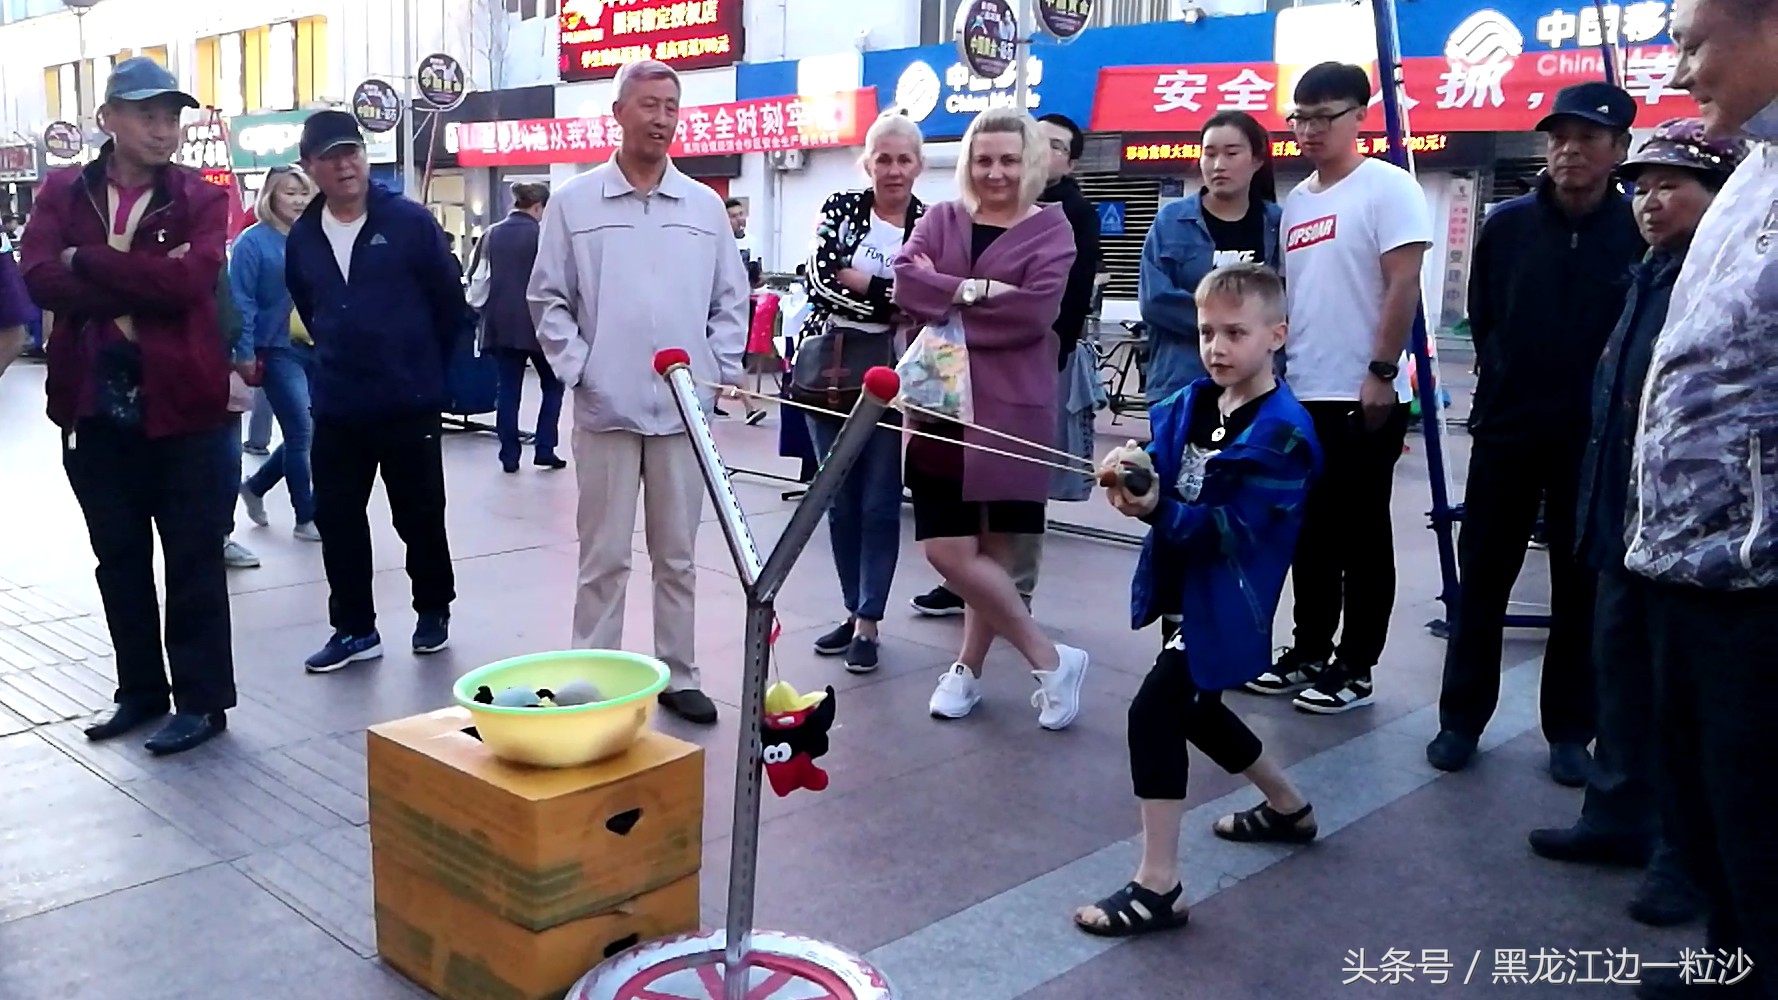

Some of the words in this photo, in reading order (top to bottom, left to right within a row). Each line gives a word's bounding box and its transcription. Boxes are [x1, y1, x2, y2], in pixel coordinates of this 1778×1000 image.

[673, 97, 838, 144] 安全时刻牢
